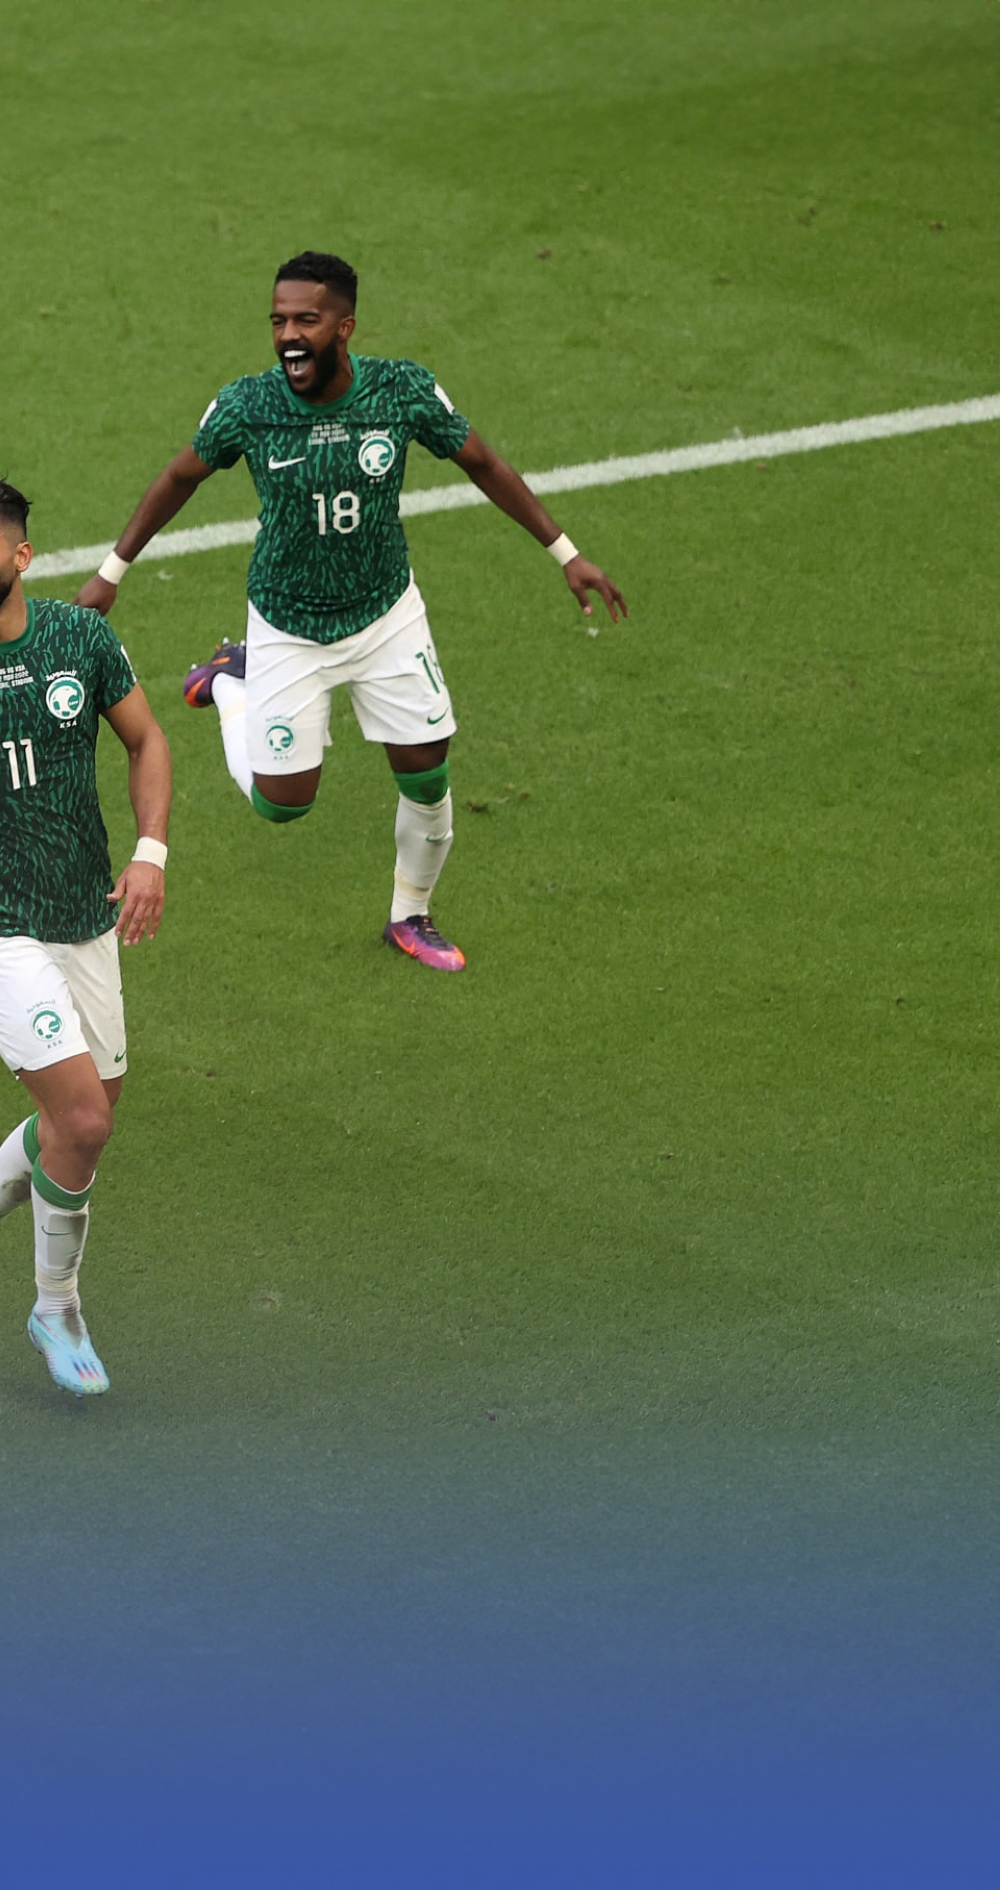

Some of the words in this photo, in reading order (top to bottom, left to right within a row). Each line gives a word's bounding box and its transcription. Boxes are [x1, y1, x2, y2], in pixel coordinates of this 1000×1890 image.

[312, 490, 360, 536] 18
[59, 720, 77, 729] KSA
[2, 738, 37, 790] 11
